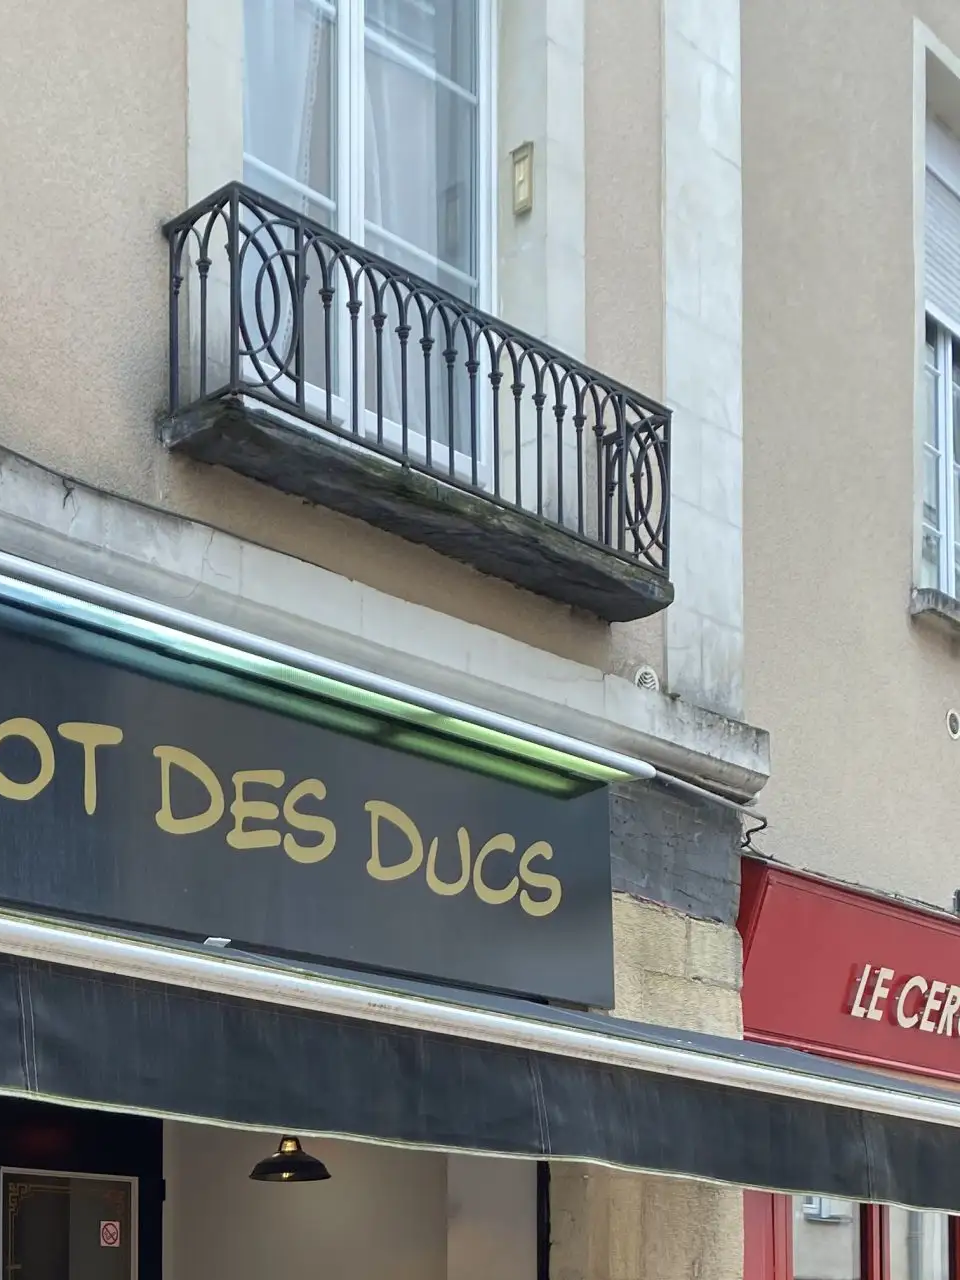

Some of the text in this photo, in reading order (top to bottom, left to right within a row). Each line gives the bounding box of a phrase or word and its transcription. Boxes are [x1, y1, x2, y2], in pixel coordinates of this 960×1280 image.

[153, 745, 336, 864] DES
[364, 800, 562, 917] DUCS
[851, 964, 960, 1037] LE CER
